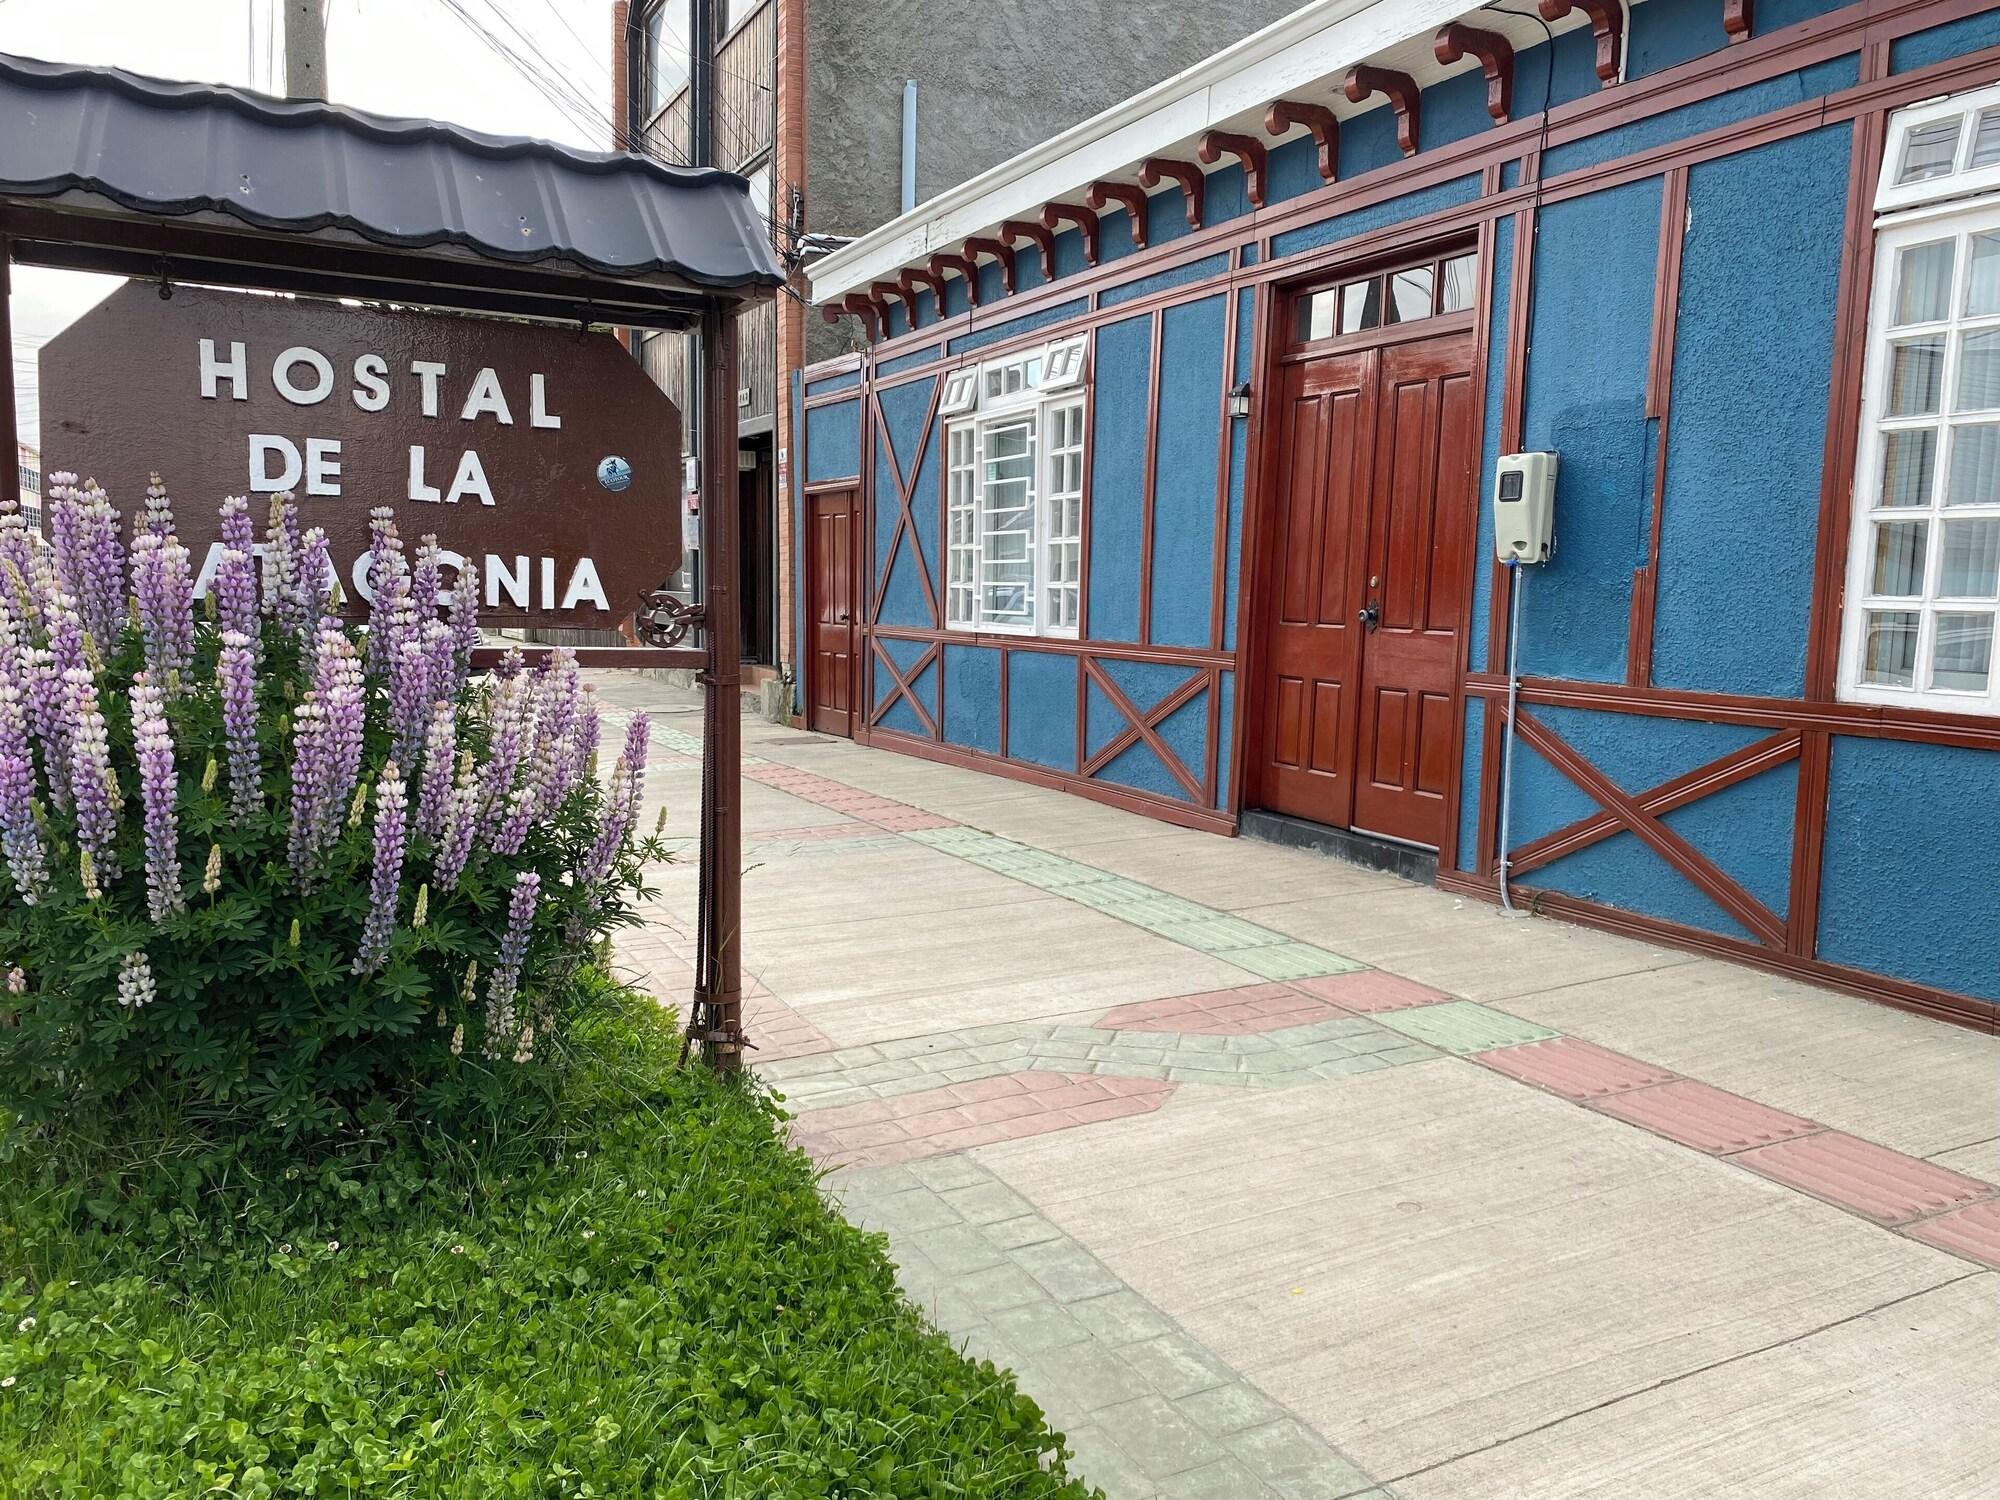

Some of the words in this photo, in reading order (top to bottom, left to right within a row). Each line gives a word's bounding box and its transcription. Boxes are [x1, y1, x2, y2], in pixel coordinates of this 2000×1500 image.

[199, 338, 561, 429] HOSTAL
[248, 434, 342, 496] DE
[408, 445, 496, 506] LA
